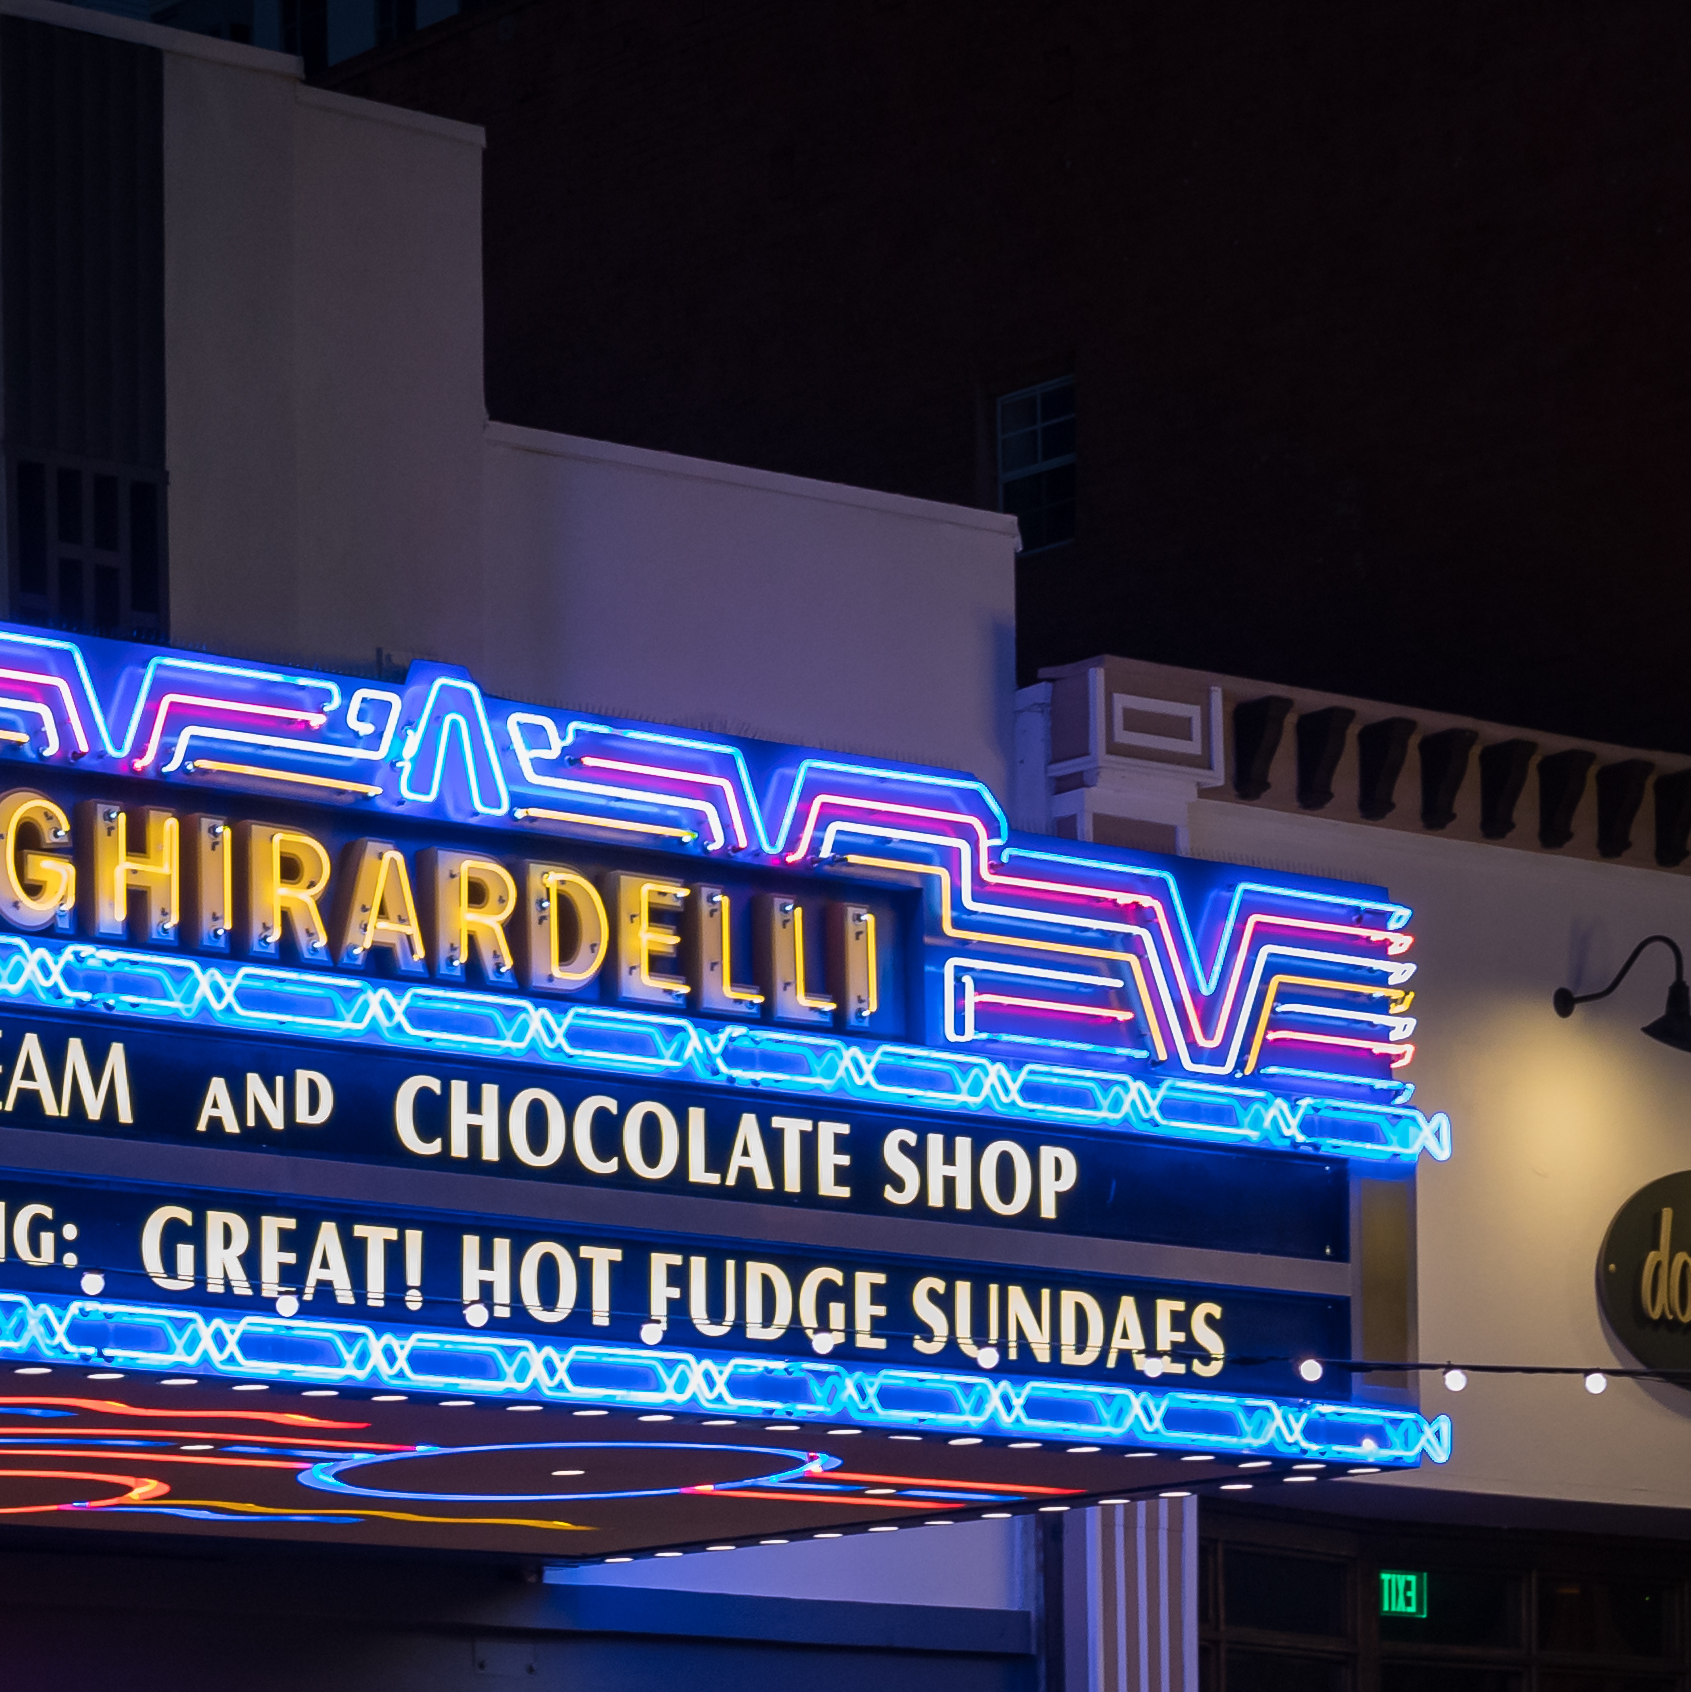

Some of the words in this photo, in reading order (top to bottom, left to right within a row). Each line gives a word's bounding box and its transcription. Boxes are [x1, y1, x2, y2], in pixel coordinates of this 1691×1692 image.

[197, 1070, 334, 1135] AND
[394, 1073, 852, 1199] CHOCOLATE
[882, 1128, 1079, 1220] SHOP
[140, 1205, 423, 1314] GREAT!
[461, 1233, 623, 1330] HOT
[648, 1252, 888, 1351] FUDGE
[911, 1276, 1226, 1378] SUNDAES
